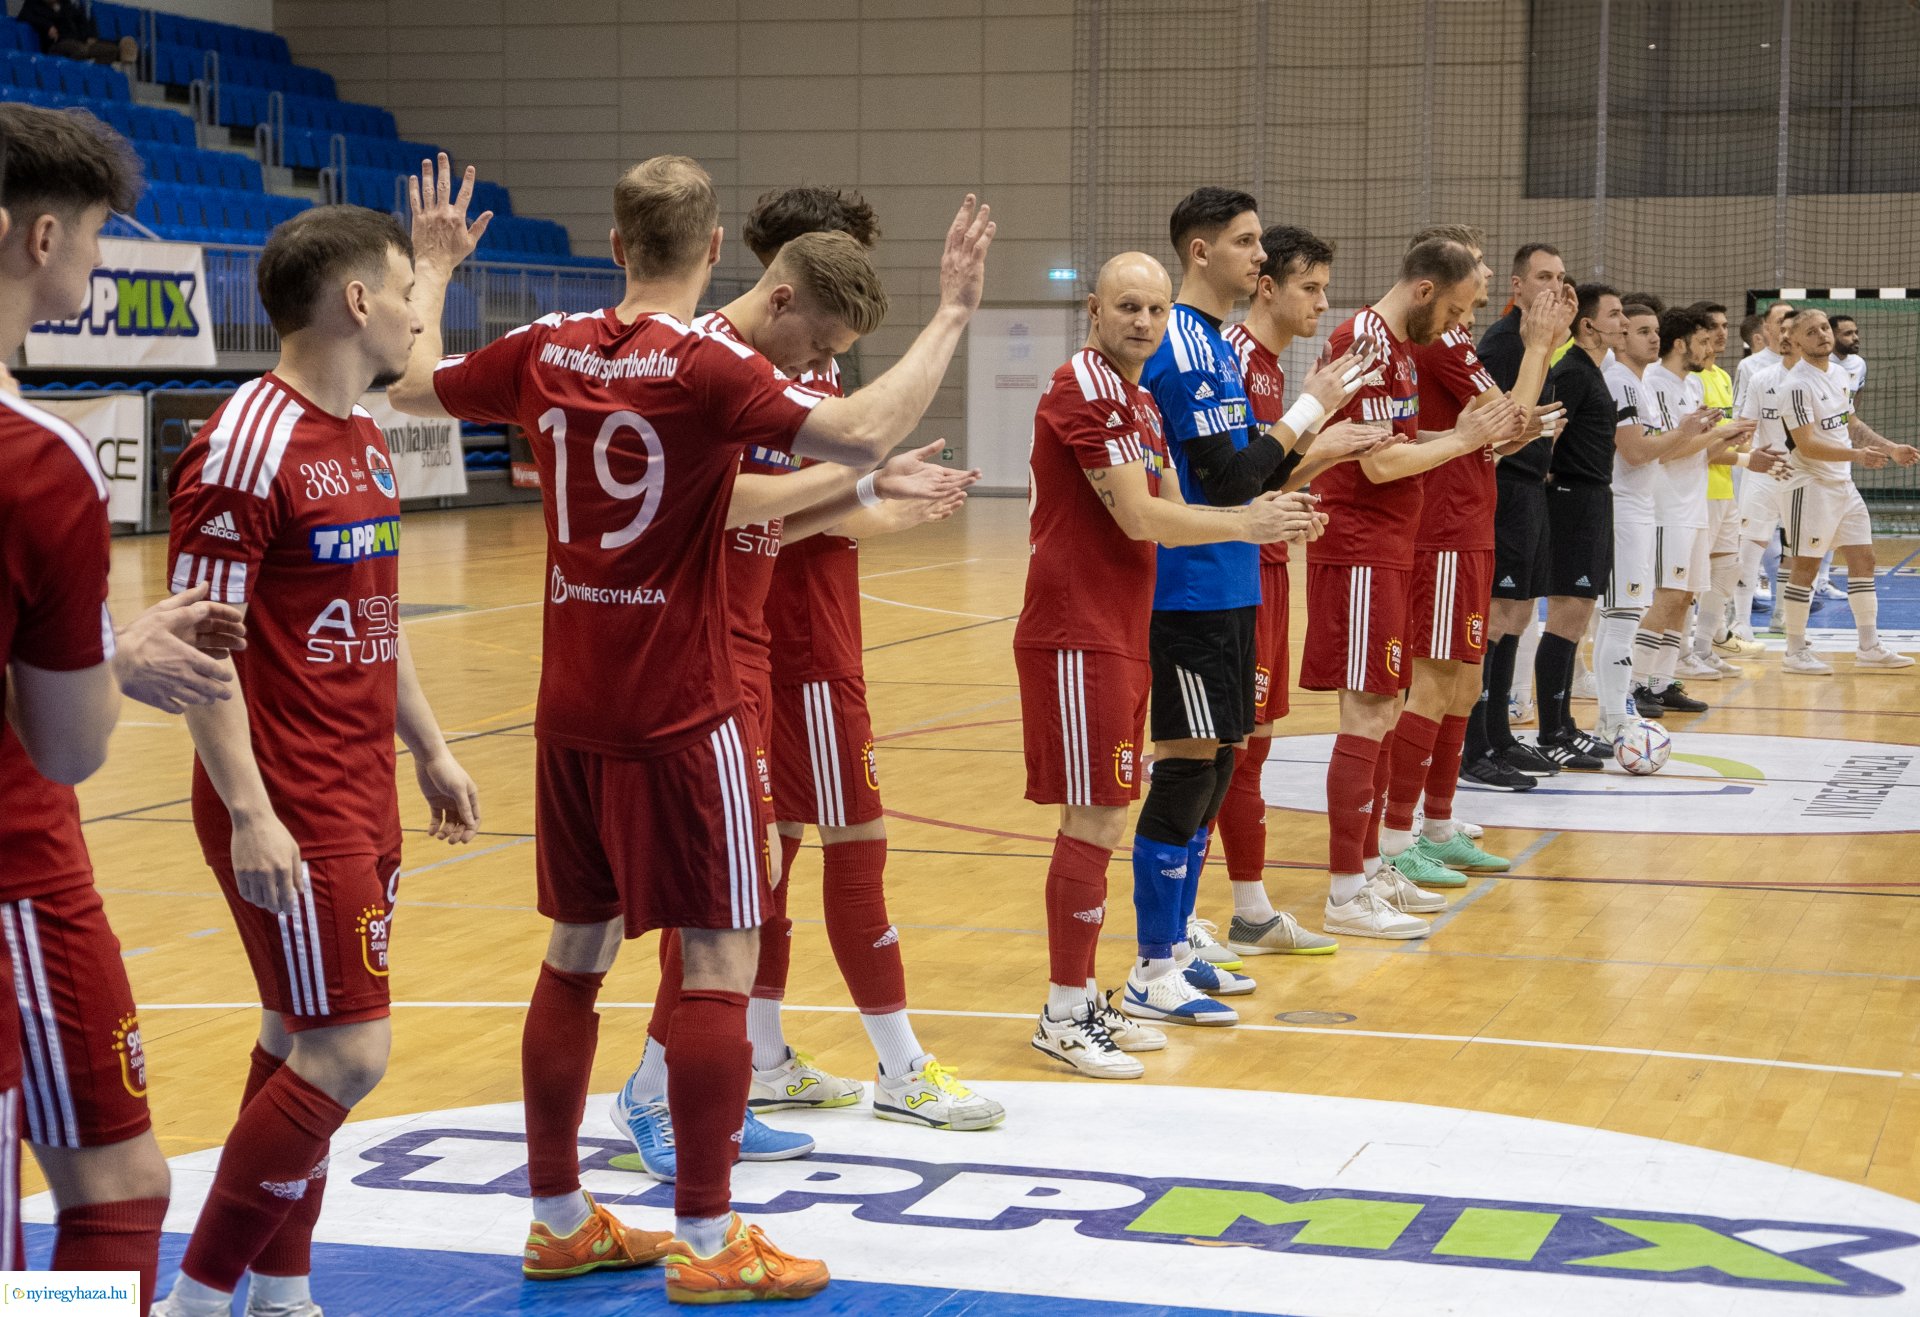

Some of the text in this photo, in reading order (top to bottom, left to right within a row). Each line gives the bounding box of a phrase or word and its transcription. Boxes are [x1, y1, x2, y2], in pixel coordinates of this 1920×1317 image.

[300, 458, 350, 500] 383
[537, 406, 665, 549] 19
[200, 525, 241, 542] adidas
[313, 520, 400, 559] TiPPMI
[567, 582, 666, 604] NYÍREGYHÁZA
